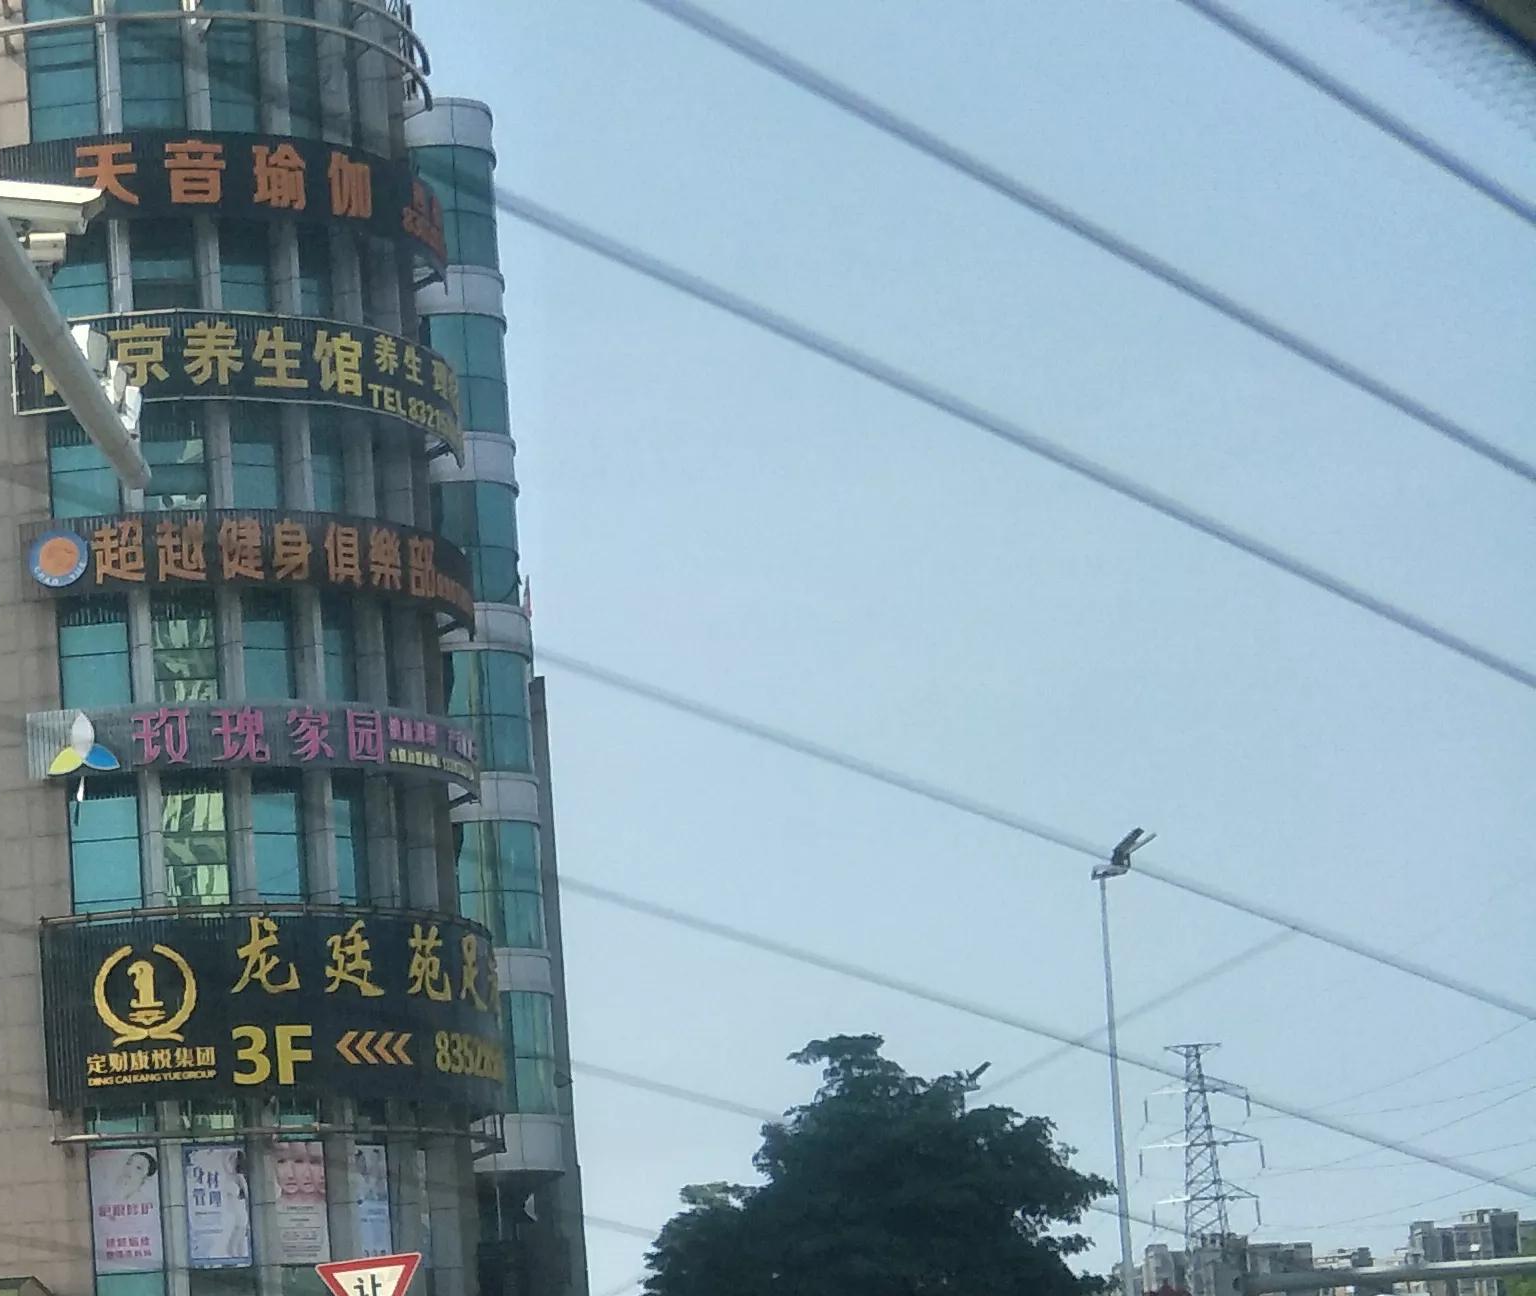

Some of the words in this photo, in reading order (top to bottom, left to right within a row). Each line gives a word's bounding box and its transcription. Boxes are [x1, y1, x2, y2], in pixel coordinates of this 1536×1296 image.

[74, 139, 372, 218] 天音瑜伽
[31, 320, 363, 397] 京养生馆
[131, 705, 386, 765] 玫瑰家园
[87, 1077, 114, 1086] DING
[183, 1069, 216, 1079] GROUP
[231, 1024, 314, 1086] 3F
